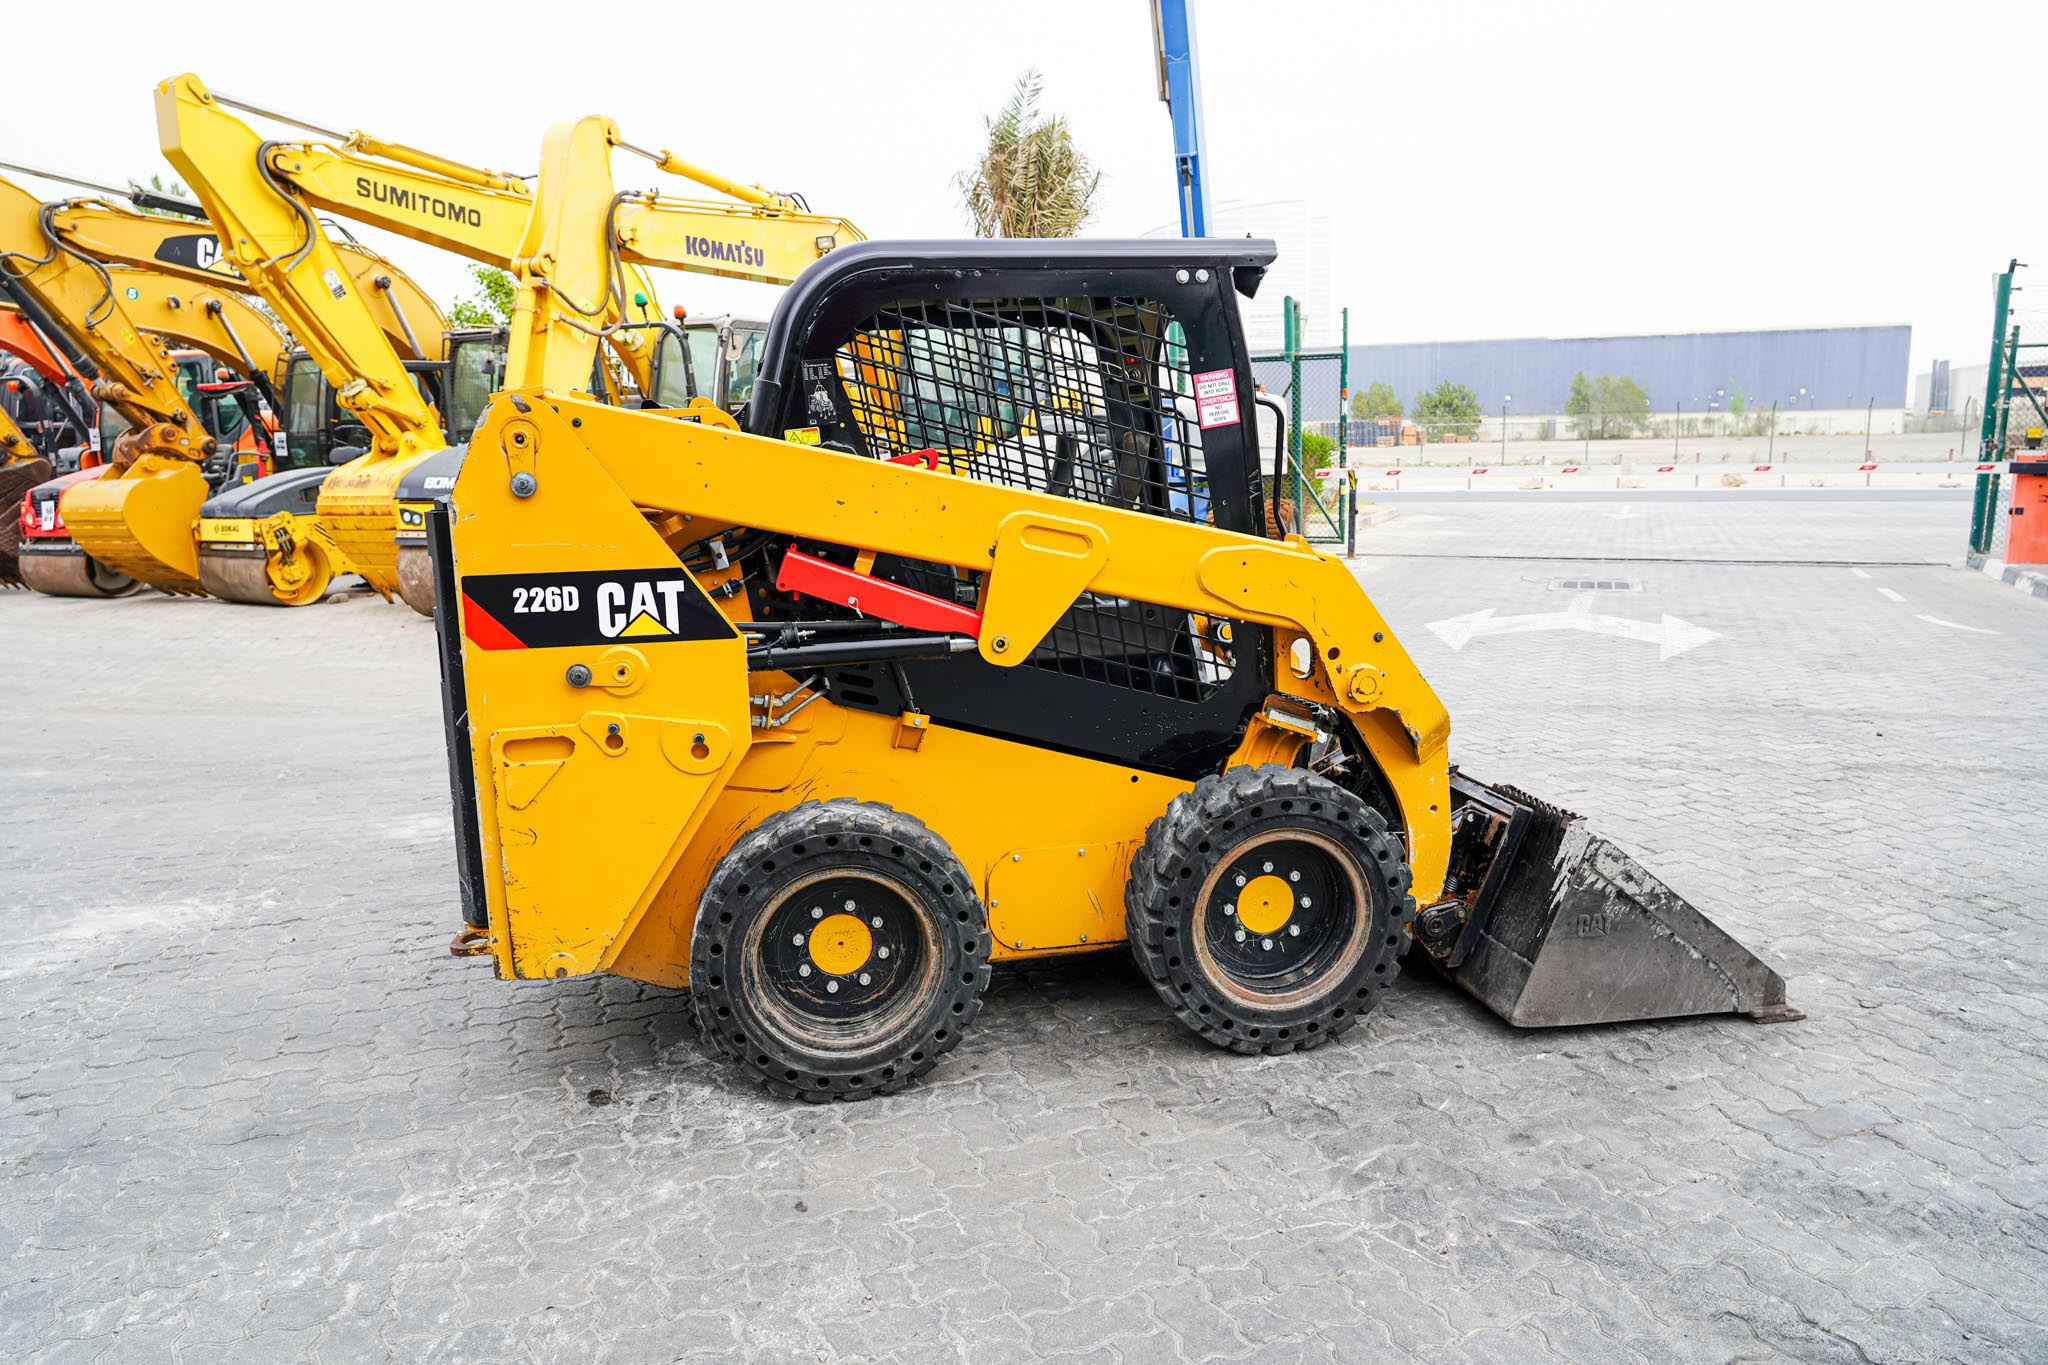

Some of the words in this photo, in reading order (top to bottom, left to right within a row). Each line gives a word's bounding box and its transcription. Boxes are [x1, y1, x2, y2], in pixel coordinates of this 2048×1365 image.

[356, 177, 481, 228] SUMITOMO
[685, 235, 764, 267] KOMATSU
[1199, 372, 1228, 381] WARNING
[512, 585, 580, 614] 226D
[596, 580, 685, 638] CAT
[1577, 913, 1612, 938] CAT
